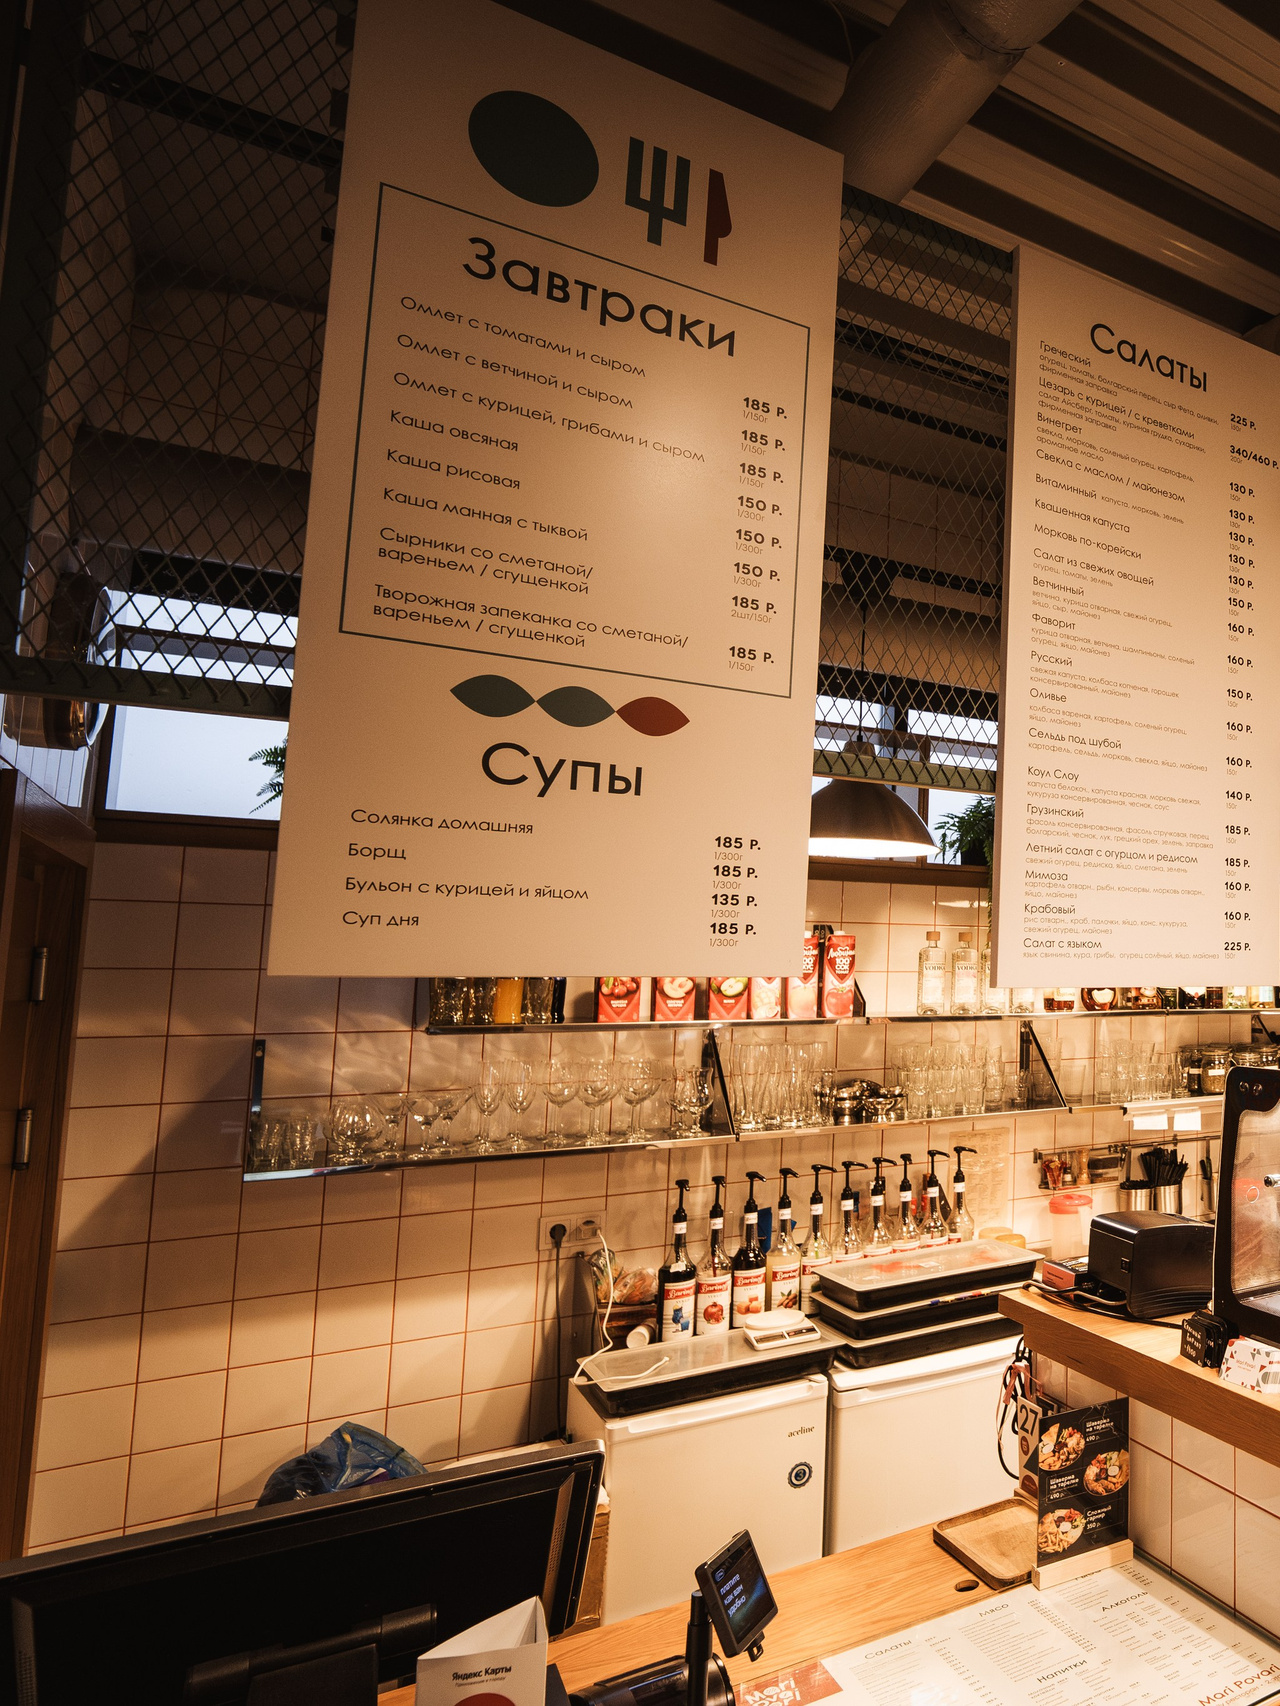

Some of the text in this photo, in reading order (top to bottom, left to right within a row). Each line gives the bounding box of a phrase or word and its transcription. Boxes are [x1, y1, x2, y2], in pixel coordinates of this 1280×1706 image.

[462, 237, 736, 358] Завтраки
[400, 296, 646, 378] Омлет с томатами и сыром
[1039, 339, 1091, 368] Греческий
[1089, 323, 1207, 393] Салаты
[397, 334, 633, 409] Омлет с ветчиной и сыром
[393, 372, 705, 463] Омлет с курицей, грибами и сыром
[742, 409, 768, 423] 1/150г
[743, 396, 788, 420] 185 Р.
[1039, 376, 1075, 397] Цезарь
[1077, 392, 1084, 401] с
[1085, 395, 1127, 415] курицей
[1133, 412, 1141, 421] с
[1142, 415, 1195, 440] креветками
[390, 409, 519, 452] Каша овсяная
[1037, 411, 1083, 435] Винегрет
[1230, 413, 1257, 431] 225 Р.
[387, 448, 521, 490] Каша рисовая
[1229, 444, 1279, 470] 340/460 Р.
[1035, 448, 1073, 468] Свекла
[1075, 462, 1082, 471] с
[1083, 465, 1125, 484] маслом
[1131, 481, 1186, 503] майонезом
[1035, 473, 1097, 500] Витаминный
[383, 487, 588, 541] Каша манная с тыквой
[1034, 497, 1131, 533] Квашенная капуста
[379, 527, 594, 580] Сырники со сметаной/
[1033, 523, 1142, 560] Морковь по-корейски
[378, 547, 475, 575] вареньем
[492, 568, 589, 595] сгущенкой
[1033, 547, 1154, 587] Салат из свежих овощей
[1032, 575, 1085, 597] Ветчинный
[374, 583, 689, 649] Творожная запеканка со сметаной/
[730, 609, 773, 624] 2шт/150г
[731, 595, 777, 615] 185 Р.
[373, 605, 471, 630] вареньем
[488, 623, 585, 648] сгущенкой
[1031, 613, 1076, 631] Фаворит
[1030, 649, 1073, 667] Русский
[1029, 687, 1067, 703] Оливье
[1028, 727, 1122, 750] Сельдь под шубой
[481, 742, 643, 798] Супы
[350, 809, 533, 835] Солянка домашняя
[1026, 803, 1084, 818] Грузинский
[348, 842, 407, 861] Борщ
[714, 835, 761, 851] 185 Р.
[1025, 842, 1199, 864] Летний салат с огурцом и редисом
[714, 851, 743, 861] 1/300г
[1025, 869, 1069, 881] Мимоза
[345, 876, 589, 900] Бульон с курицей и яйцом
[342, 910, 419, 928] Суп дня
[711, 909, 740, 919] 1/300г
[1024, 903, 1076, 915] Крабовый
[1023, 937, 1103, 949] Салат с языком
[1223, 941, 1251, 951] 225 Р.
[788, 1426, 814, 1438] aceline
[1020, 1404, 1038, 1436] 27
[1101, 1591, 1149, 1613] Алкоголь
[864, 1639, 912, 1660] Салаты
[451, 1665, 512, 1681] Яндекс Карты
[1036, 1659, 1088, 1684] Напитки
[1198, 1663, 1280, 1706] Mari Povari
